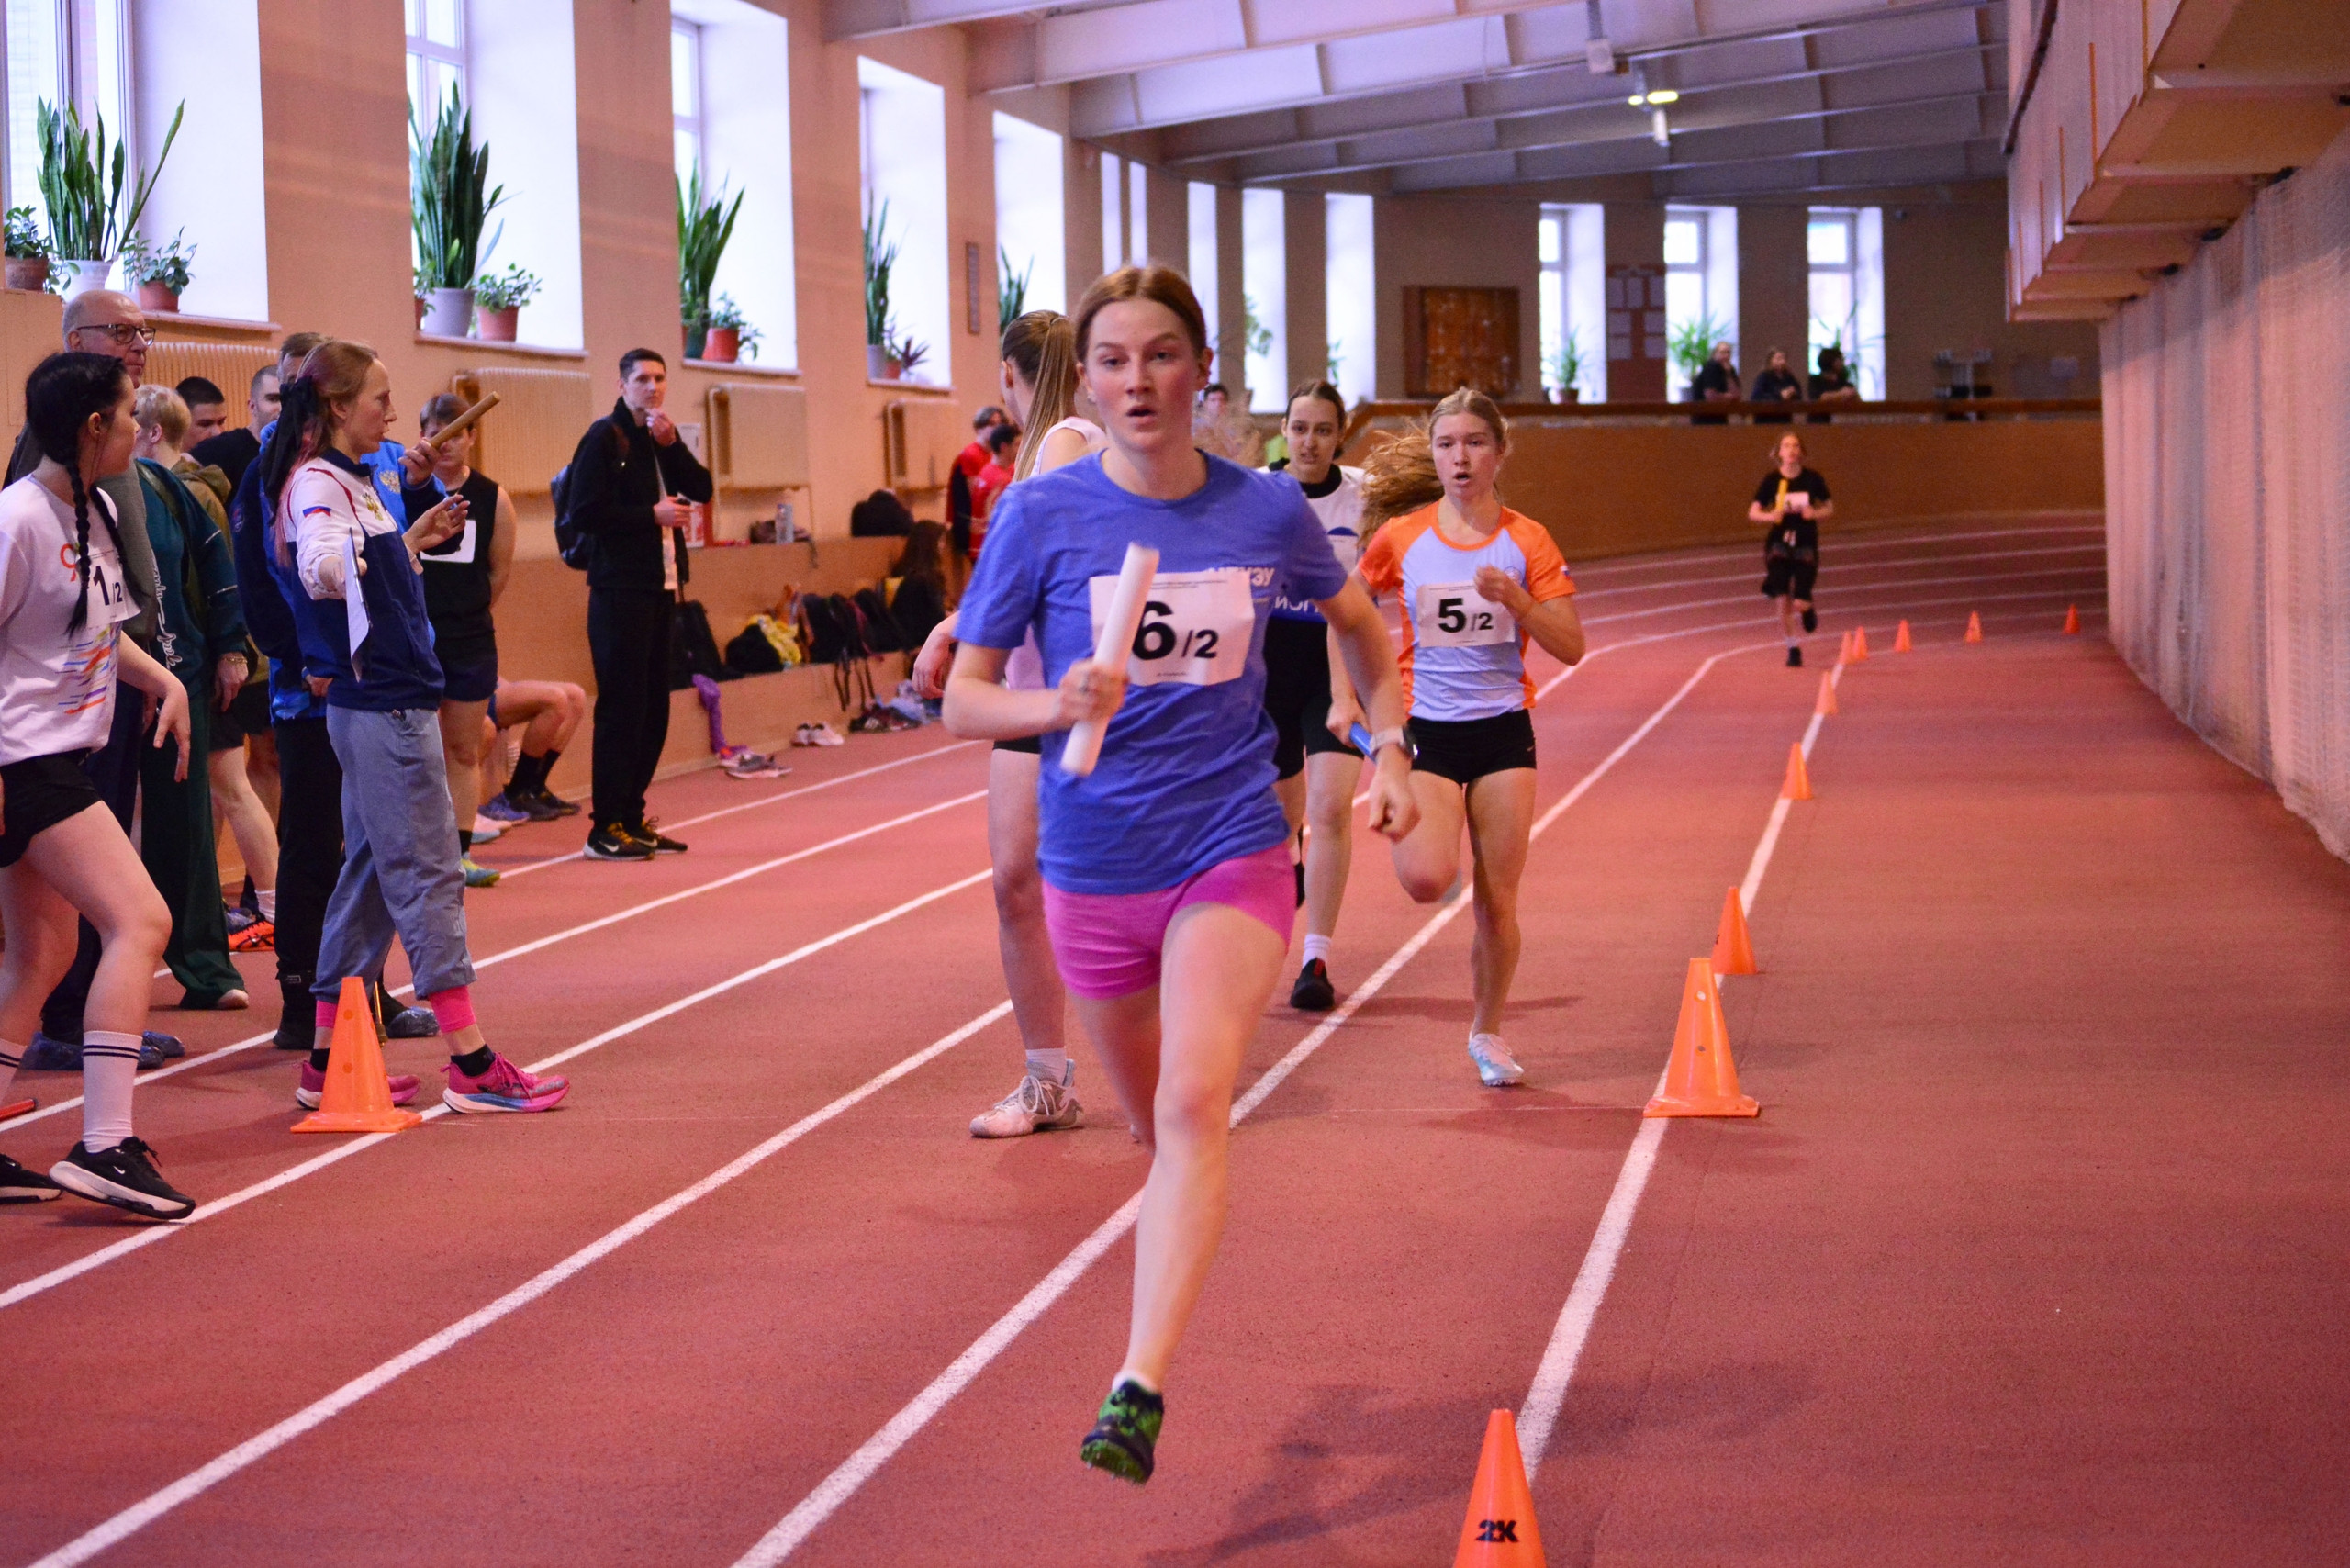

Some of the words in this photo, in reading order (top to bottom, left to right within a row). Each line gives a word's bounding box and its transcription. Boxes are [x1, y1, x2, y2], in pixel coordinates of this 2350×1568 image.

[93, 565, 123, 606] 1/2
[1132, 600, 1219, 661] 6/2
[1438, 598, 1494, 633] 5/2
[1474, 1519, 1519, 1543] 2K
